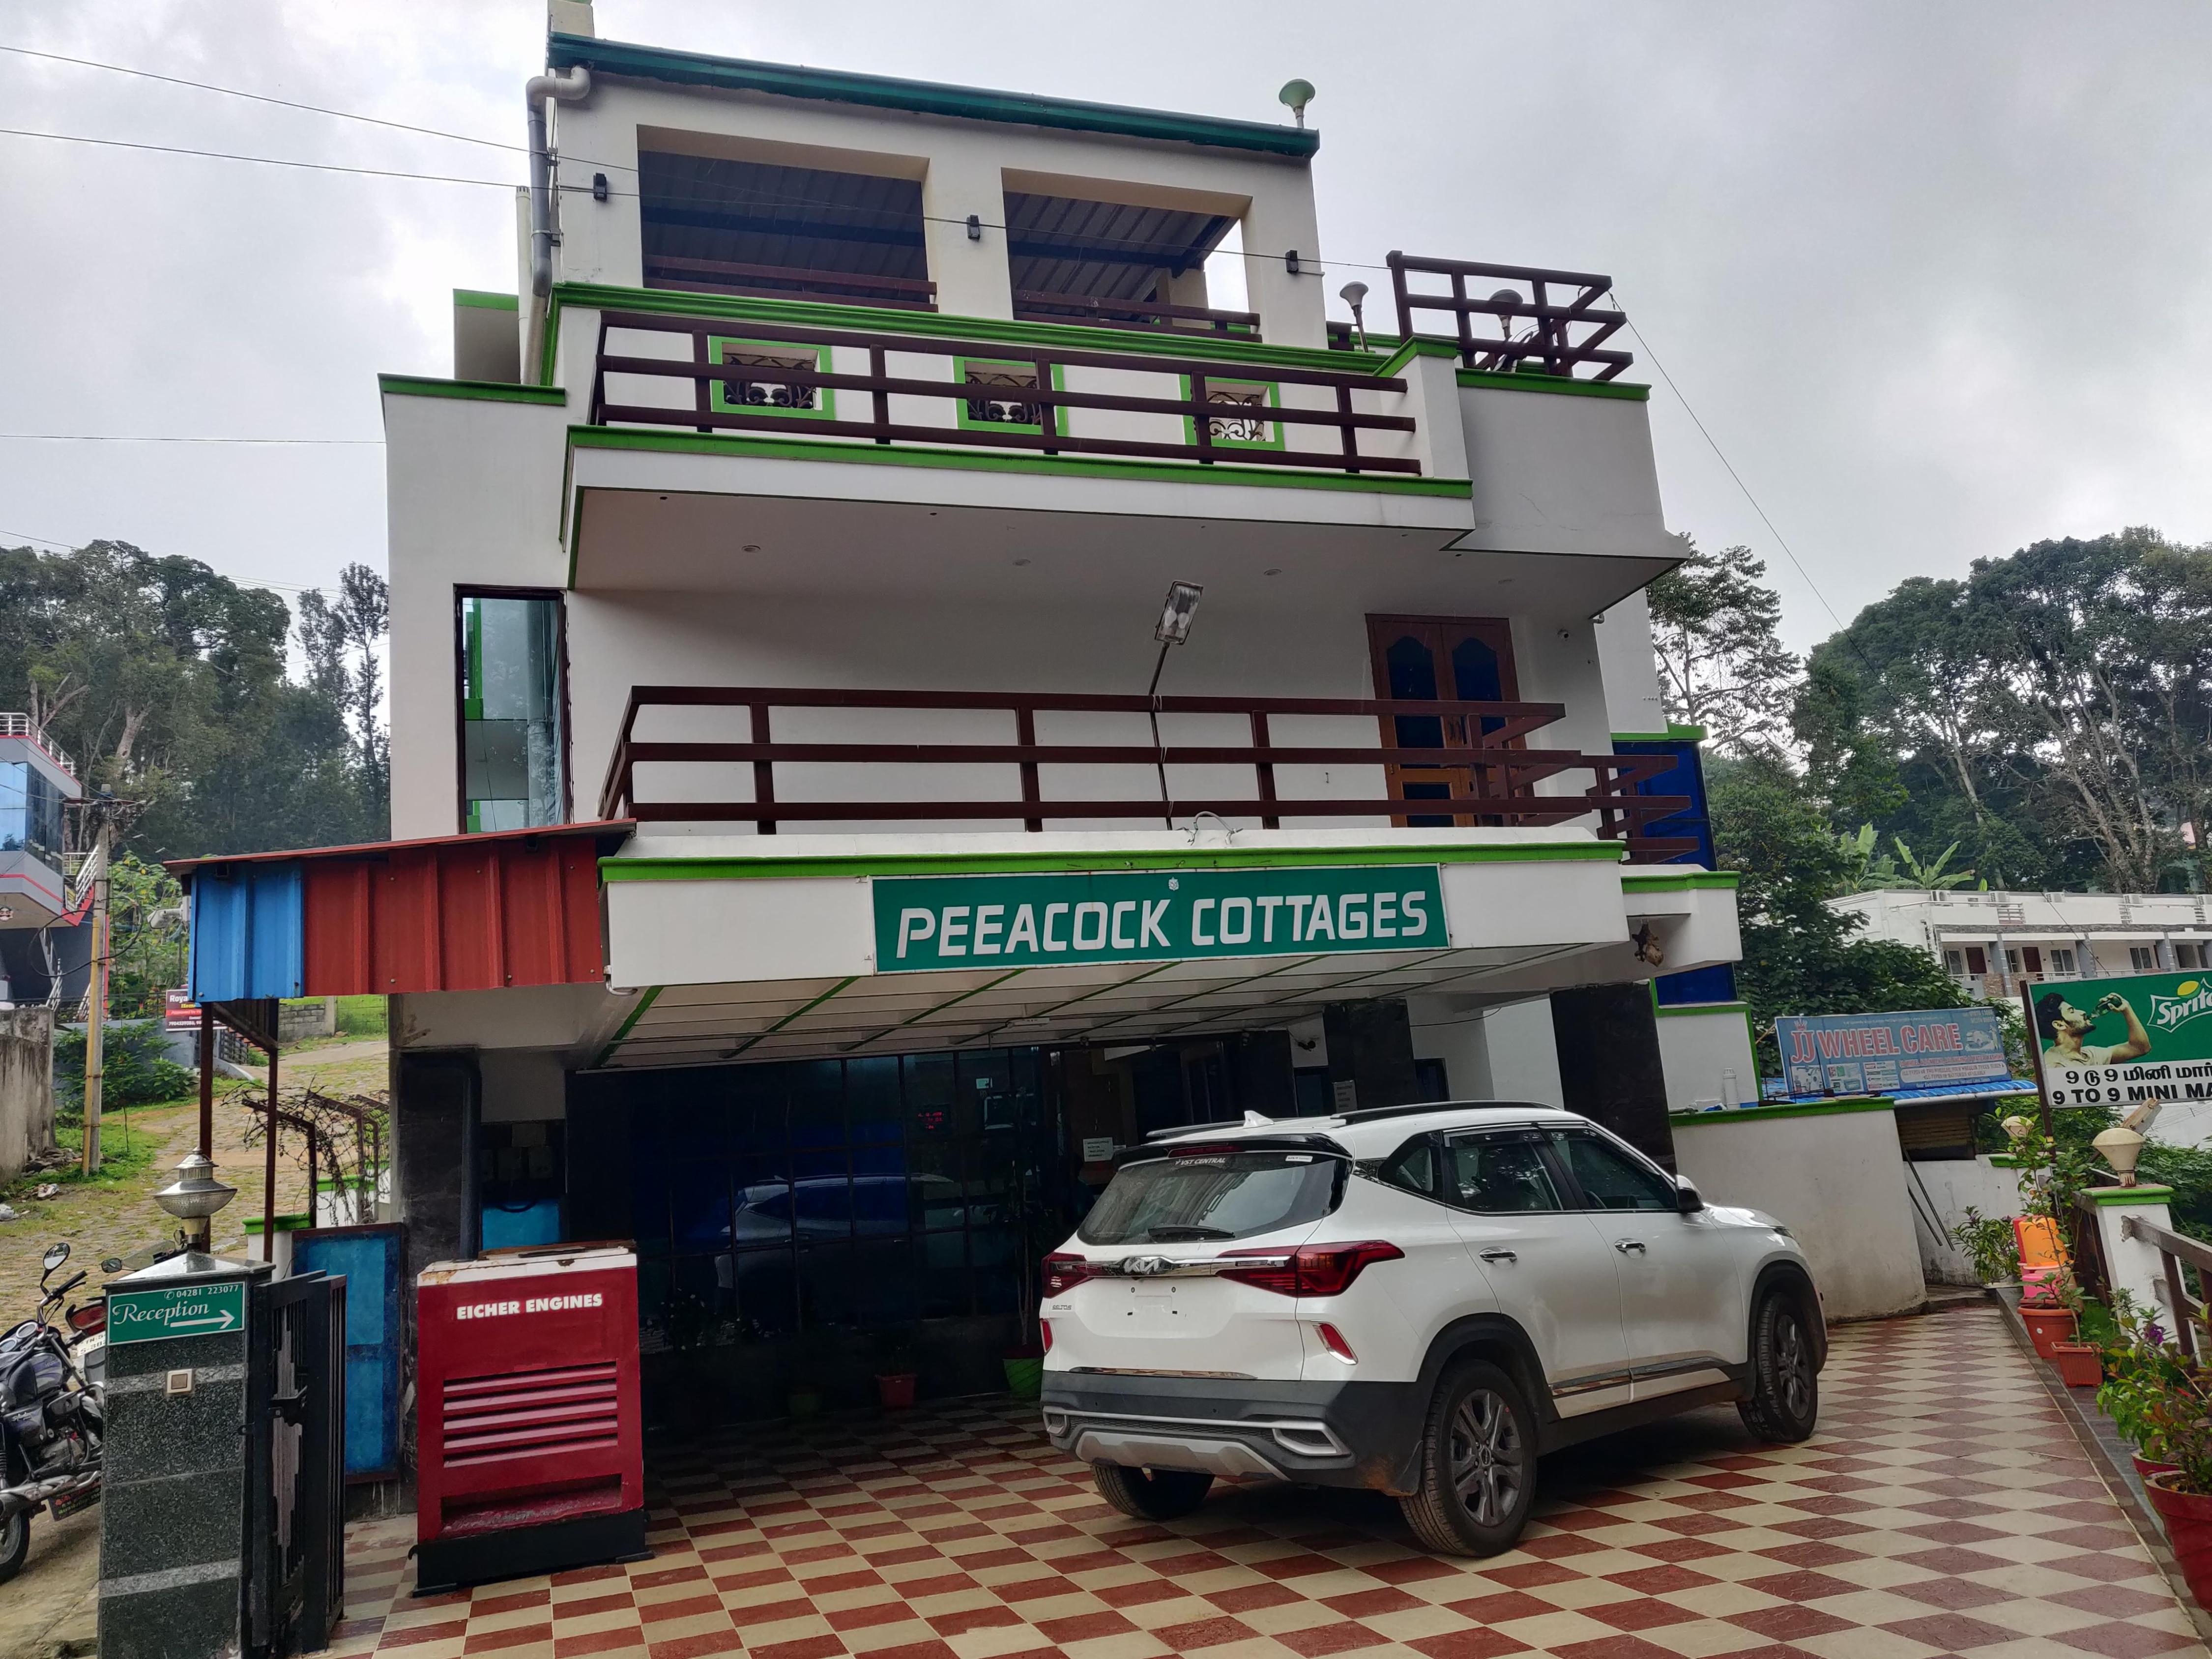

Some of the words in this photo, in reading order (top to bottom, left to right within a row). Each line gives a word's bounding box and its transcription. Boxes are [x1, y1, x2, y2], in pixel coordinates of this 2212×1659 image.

[897, 899, 1171, 959] PEEACOCK
[1191, 890, 1427, 947] COTTAGES
[1791, 1030, 1816, 1063] JJ
[1816, 1027, 1900, 1058] WHEEL
[1900, 1023, 1963, 1053] CARE
[2123, 1065, 2172, 1081] மினி
[2052, 1091, 2066, 1105] 9
[2071, 1088, 2100, 1103] TO
[2107, 1088, 2120, 1102] 9
[2127, 1084, 2178, 1101] MINI
[207, 1284, 239, 1295] 223077
[112, 1301, 210, 1326] Reception
[457, 1301, 520, 1320] EICHER
[526, 1293, 602, 1313] ENGINES
